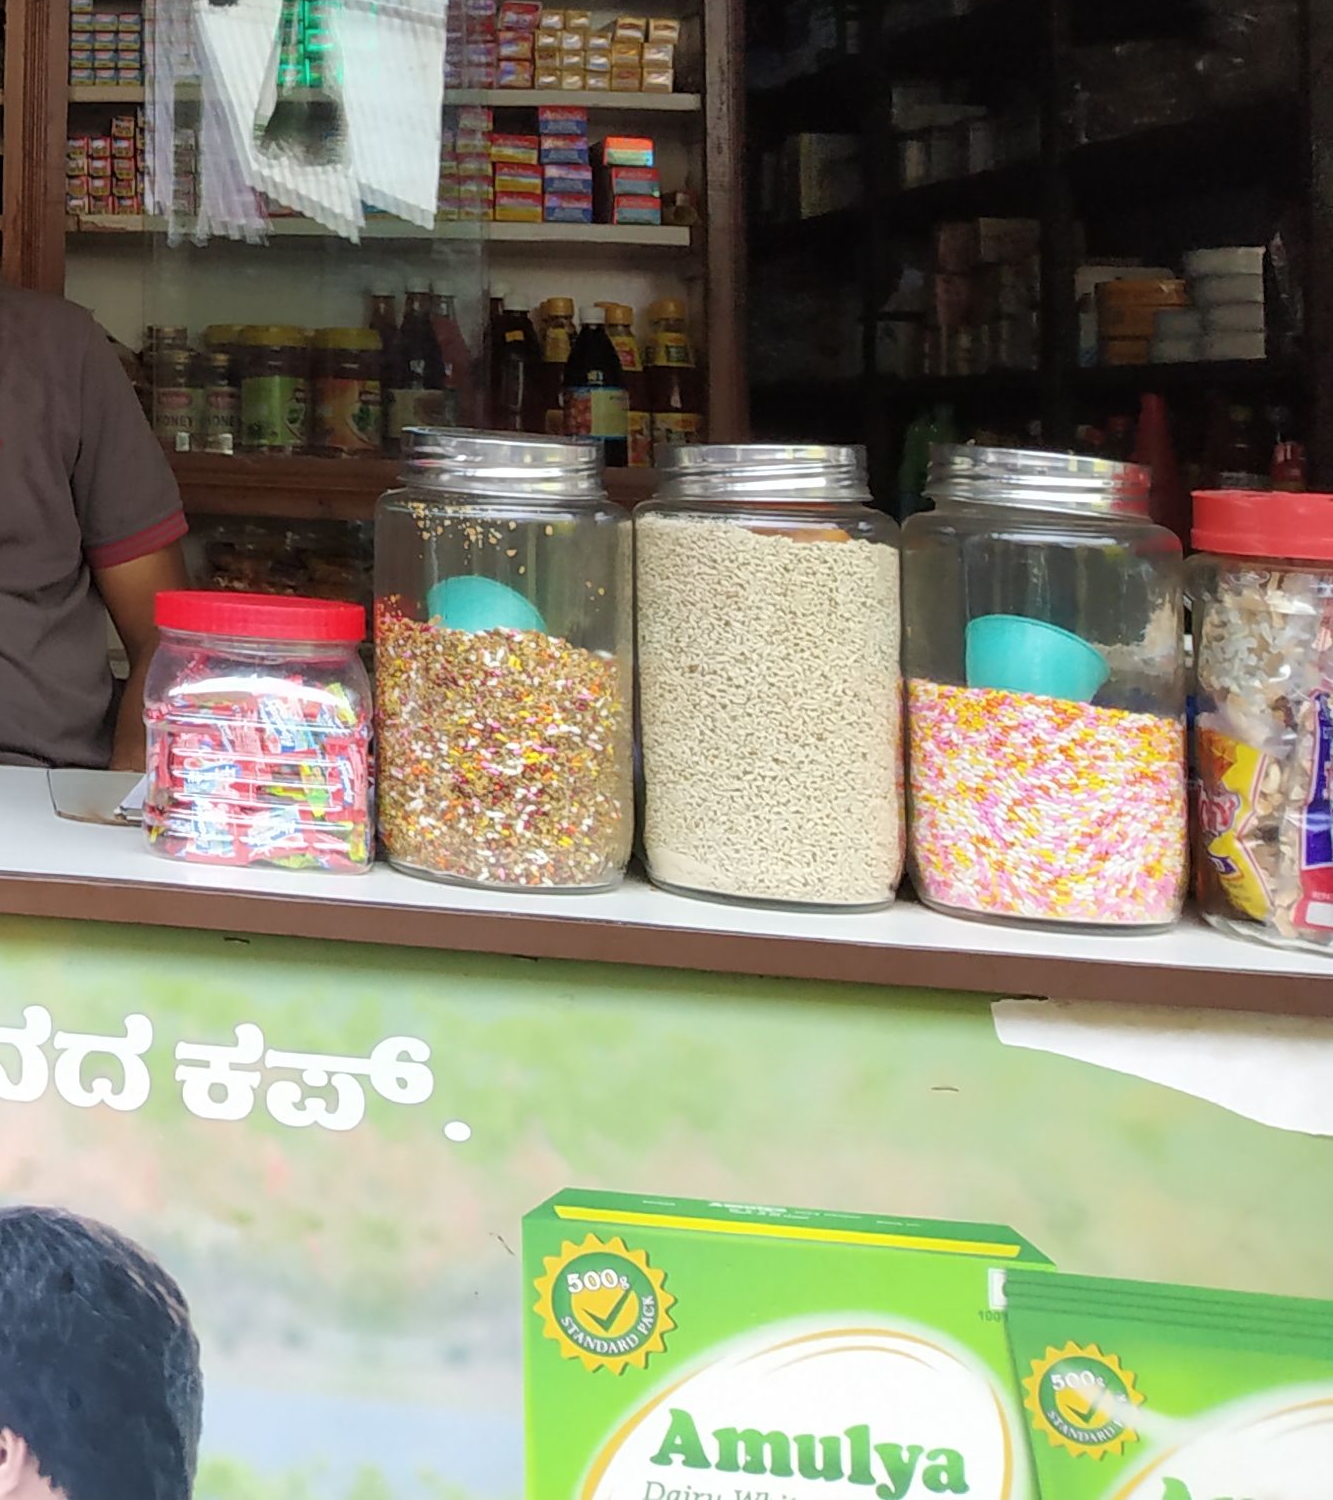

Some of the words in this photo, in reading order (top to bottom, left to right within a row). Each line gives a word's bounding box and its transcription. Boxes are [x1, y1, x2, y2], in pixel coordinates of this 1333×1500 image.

[566, 1268, 631, 1294] 500g
[560, 1314, 640, 1355] STANDARD
[635, 1295, 655, 1336] PACK
[1046, 1410, 1116, 1444] STANDARD
[649, 1407, 970, 1500] Amulya
